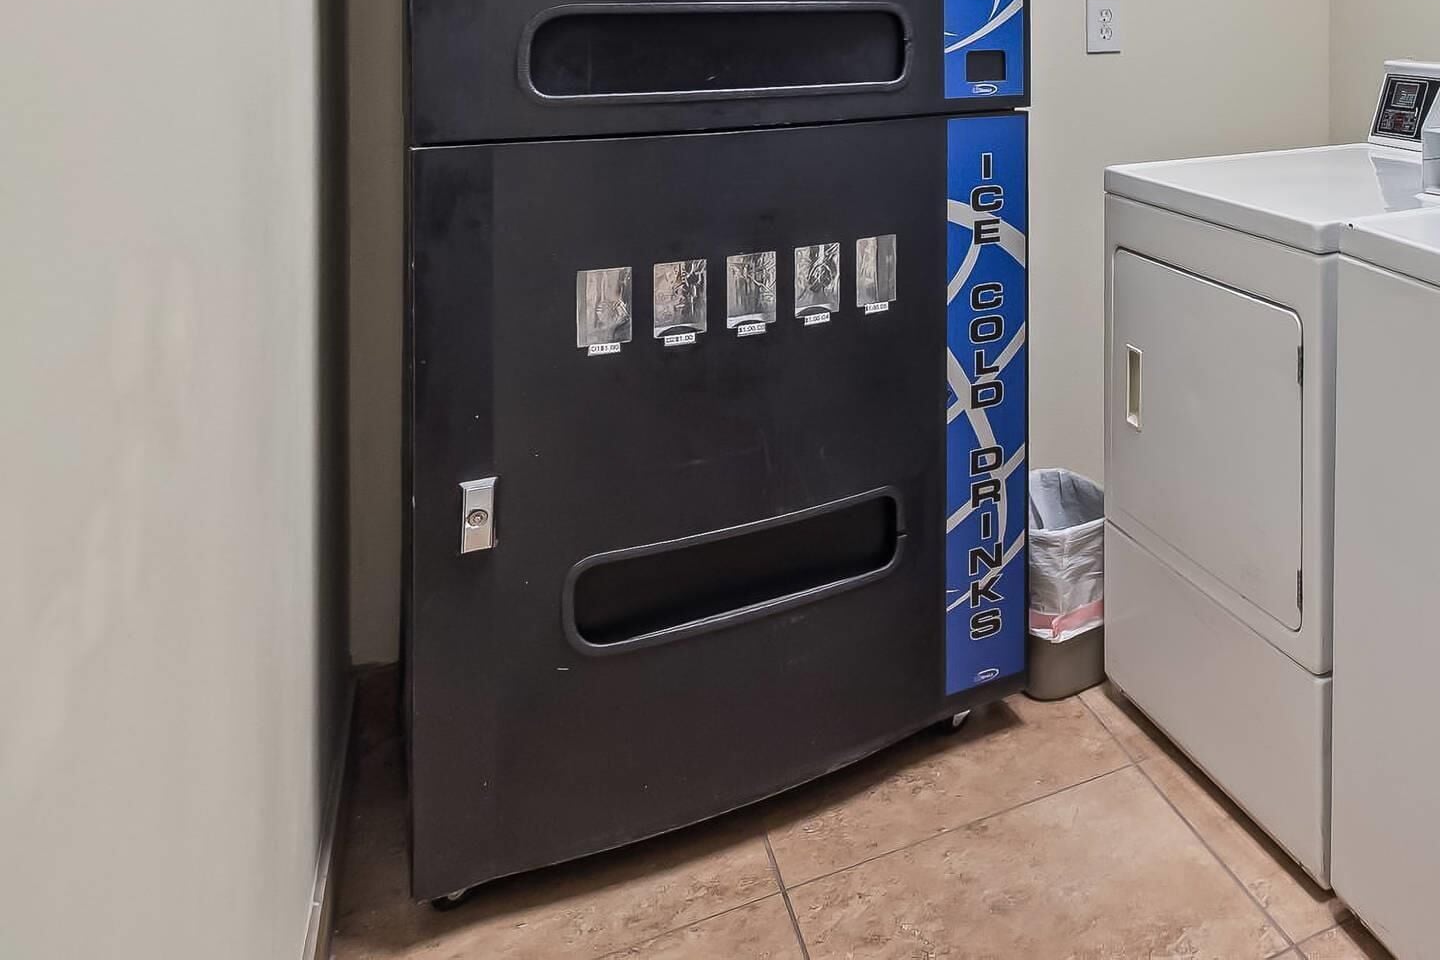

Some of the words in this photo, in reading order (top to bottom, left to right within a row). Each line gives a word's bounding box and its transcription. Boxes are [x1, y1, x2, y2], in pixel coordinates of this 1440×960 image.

[969, 152, 1004, 246] ICE
[969, 281, 1004, 411] COLD
[968, 444, 1005, 641] DRINKS
